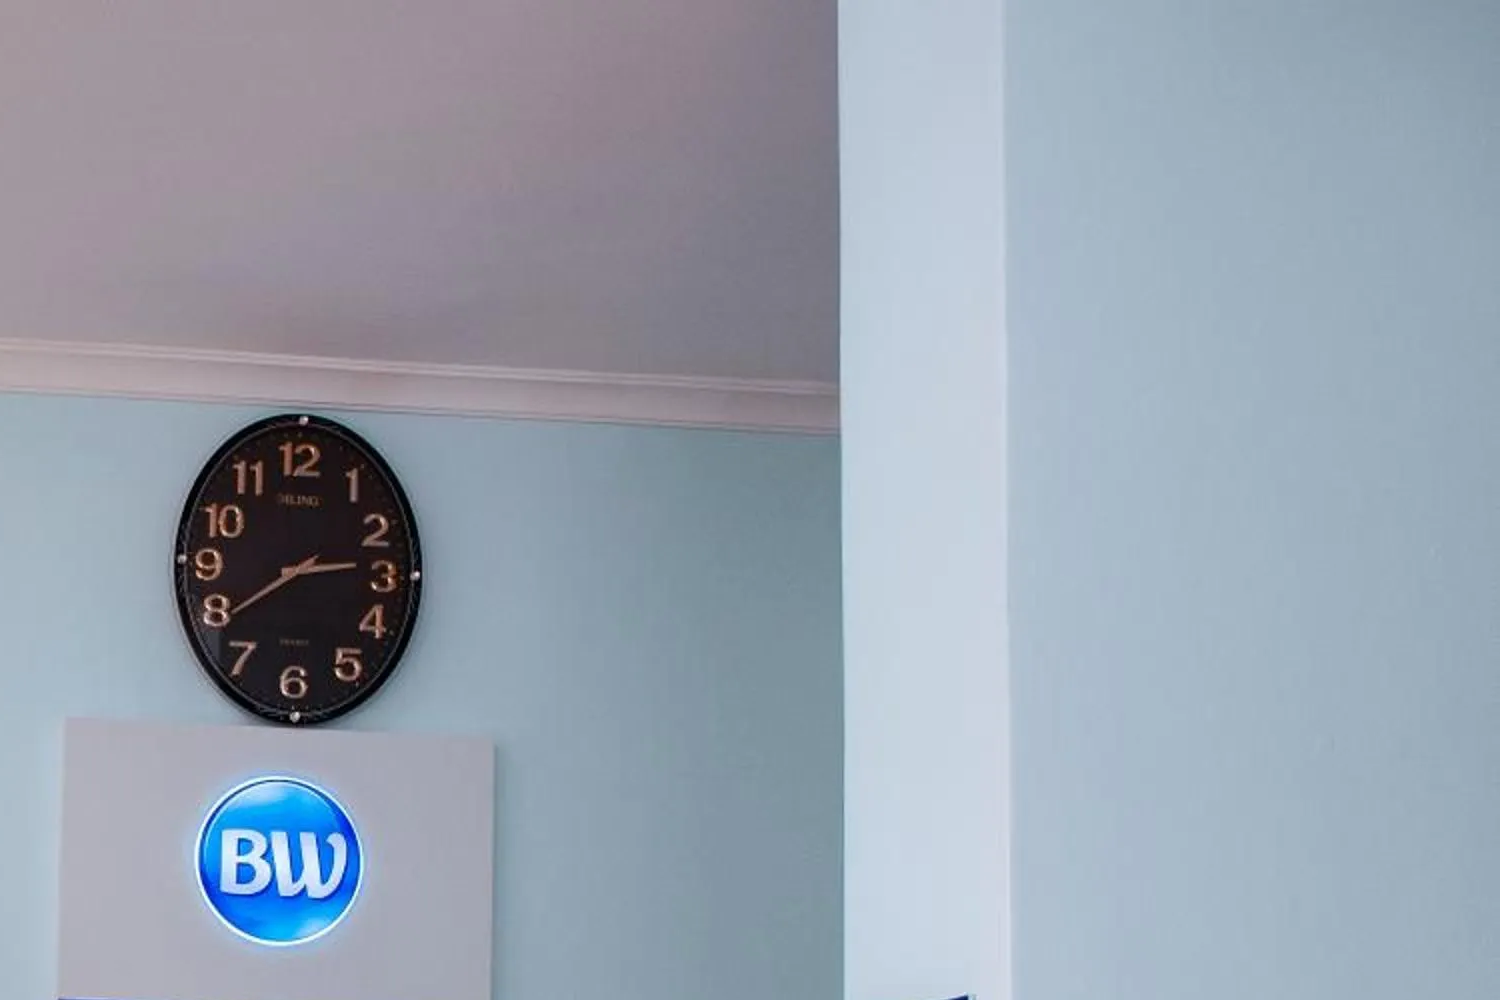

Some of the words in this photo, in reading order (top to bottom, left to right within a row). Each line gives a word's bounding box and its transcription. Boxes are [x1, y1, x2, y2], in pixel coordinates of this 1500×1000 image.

[279, 441, 321, 477] 12
[232, 460, 263, 496] 11
[346, 467, 359, 503] 1
[204, 503, 244, 538] 10
[362, 513, 389, 547] 2
[195, 549, 223, 581] 9
[370, 560, 397, 593] 3
[203, 594, 230, 627] 8
[359, 604, 386, 639] 4
[228, 641, 258, 676] 7
[334, 648, 363, 681] 5
[279, 666, 308, 699] 6
[219, 829, 347, 898] BW
